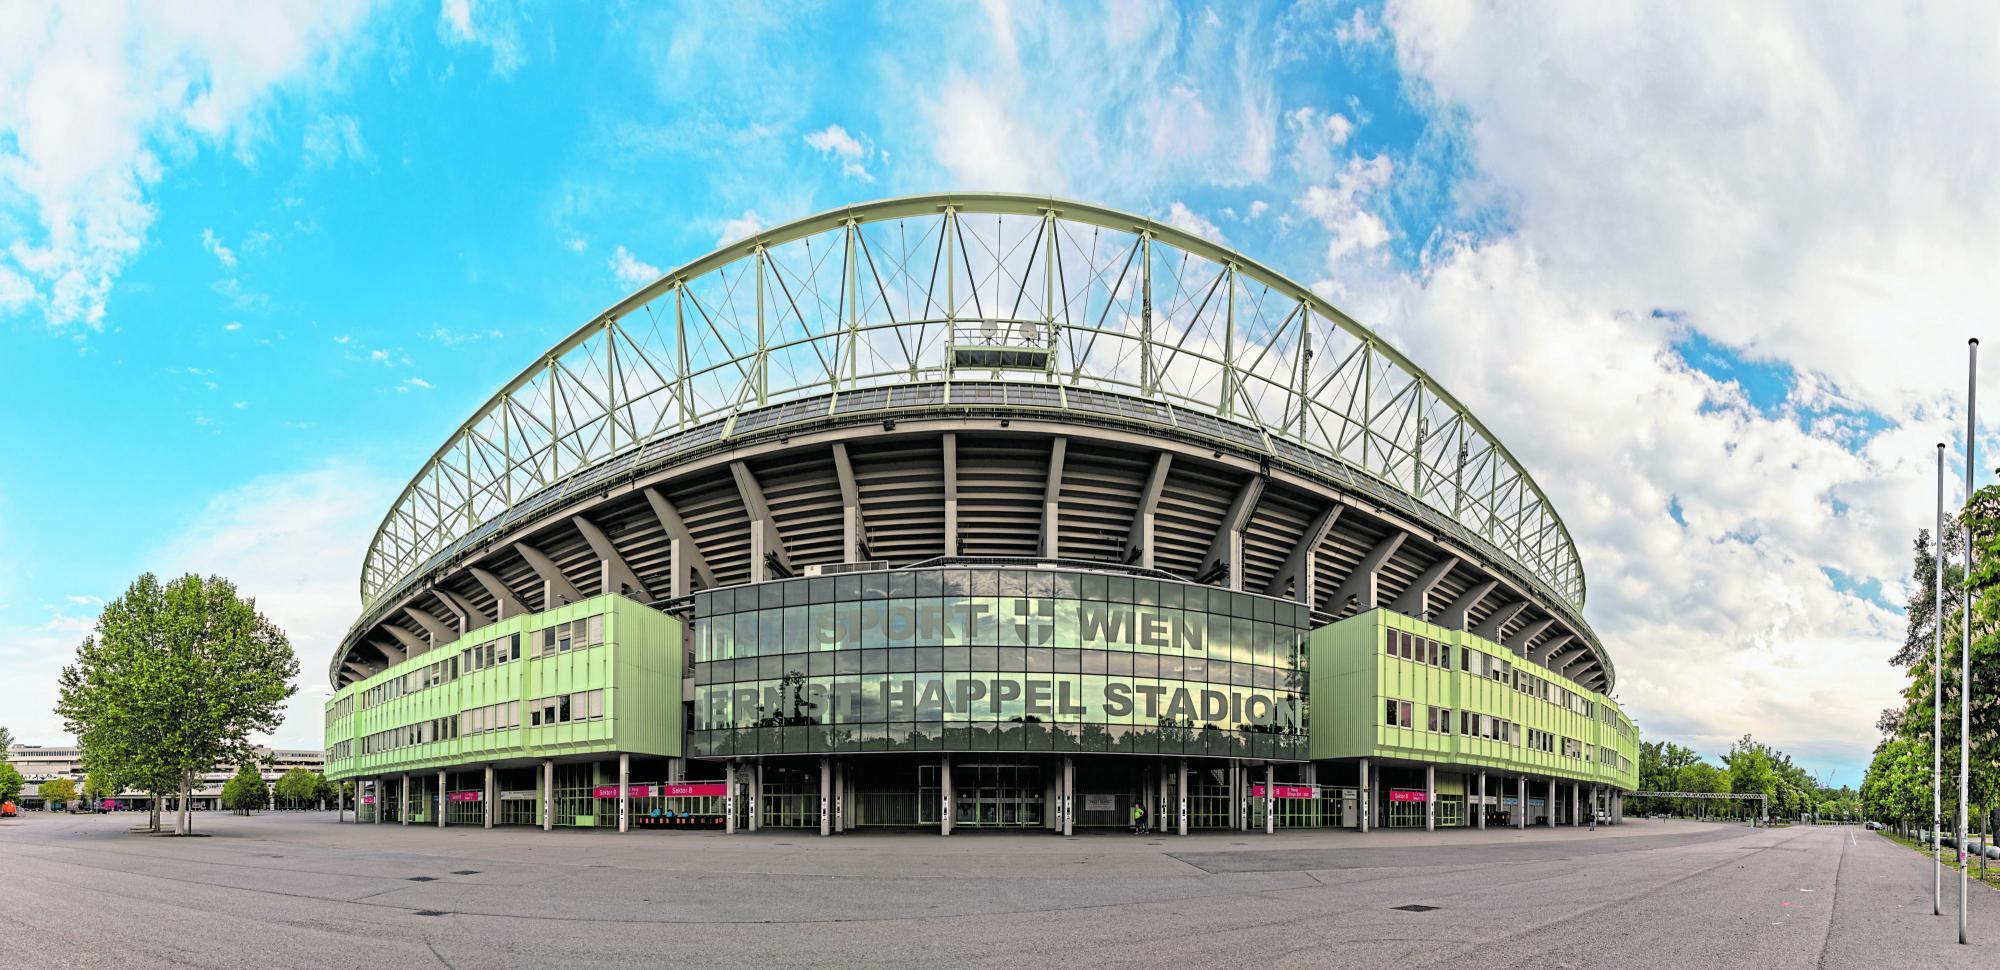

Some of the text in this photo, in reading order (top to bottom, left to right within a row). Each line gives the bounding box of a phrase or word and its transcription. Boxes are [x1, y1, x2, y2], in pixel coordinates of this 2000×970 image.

[815, 604, 1203, 650] SPORT WIEN
[703, 679, 1303, 728] ERNST HAPPEL STADION
